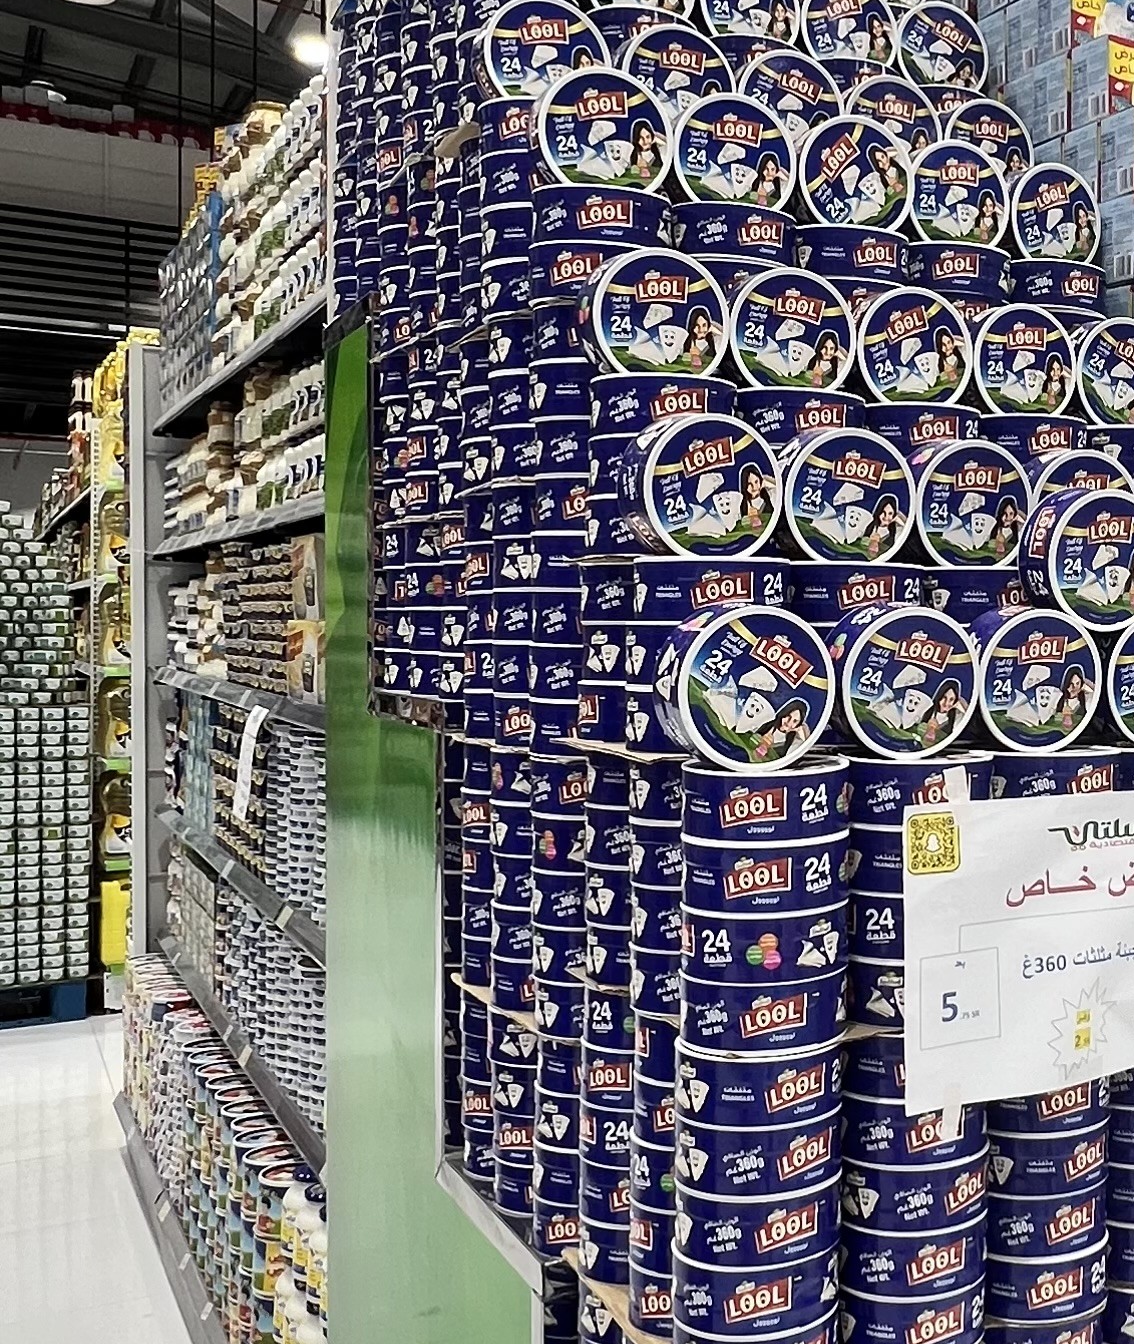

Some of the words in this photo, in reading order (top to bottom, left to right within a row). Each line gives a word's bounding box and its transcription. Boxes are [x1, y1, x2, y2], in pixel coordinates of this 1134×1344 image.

[522, 23, 565, 39] LOOL
[579, 96, 623, 115] LOOL
[556, 135, 578, 150] 24
[823, 142, 855, 175] LOOL
[942, 167, 975, 181] LOOL
[580, 205, 628, 223] LOOL
[639, 279, 683, 298] LOOL
[610, 316, 632, 331] 24
[1009, 330, 1043, 346] LOOL
[654, 396, 704, 415] LOOL
[684, 443, 730, 471] LOOL
[958, 470, 997, 486] LOOL
[1091, 519, 1129, 541] LOOL
[1063, 558, 1082, 574] 24
[696, 577, 749, 599] LOOL
[764, 573, 783, 593] 24
[756, 639, 802, 679] LOOL
[900, 640, 943, 664] LOOL
[1021, 639, 1062, 660] LOOL
[706, 651, 732, 675] 24
[992, 679, 1012, 696] 24
[800, 784, 828, 810] 24
[723, 797, 780, 823] LOOL
[1005, 865, 1096, 907] خاص
[866, 908, 895, 929] 24
[702, 929, 731, 952] 24
[1073, 949, 1112, 966] مثلثات
[744, 1002, 801, 1031] LOOL
[942, 991, 958, 1022] 5
[590, 1068, 626, 1087] LOOL
[769, 1072, 821, 1105] LOOL
[729, 1289, 785, 1316] LOOL
